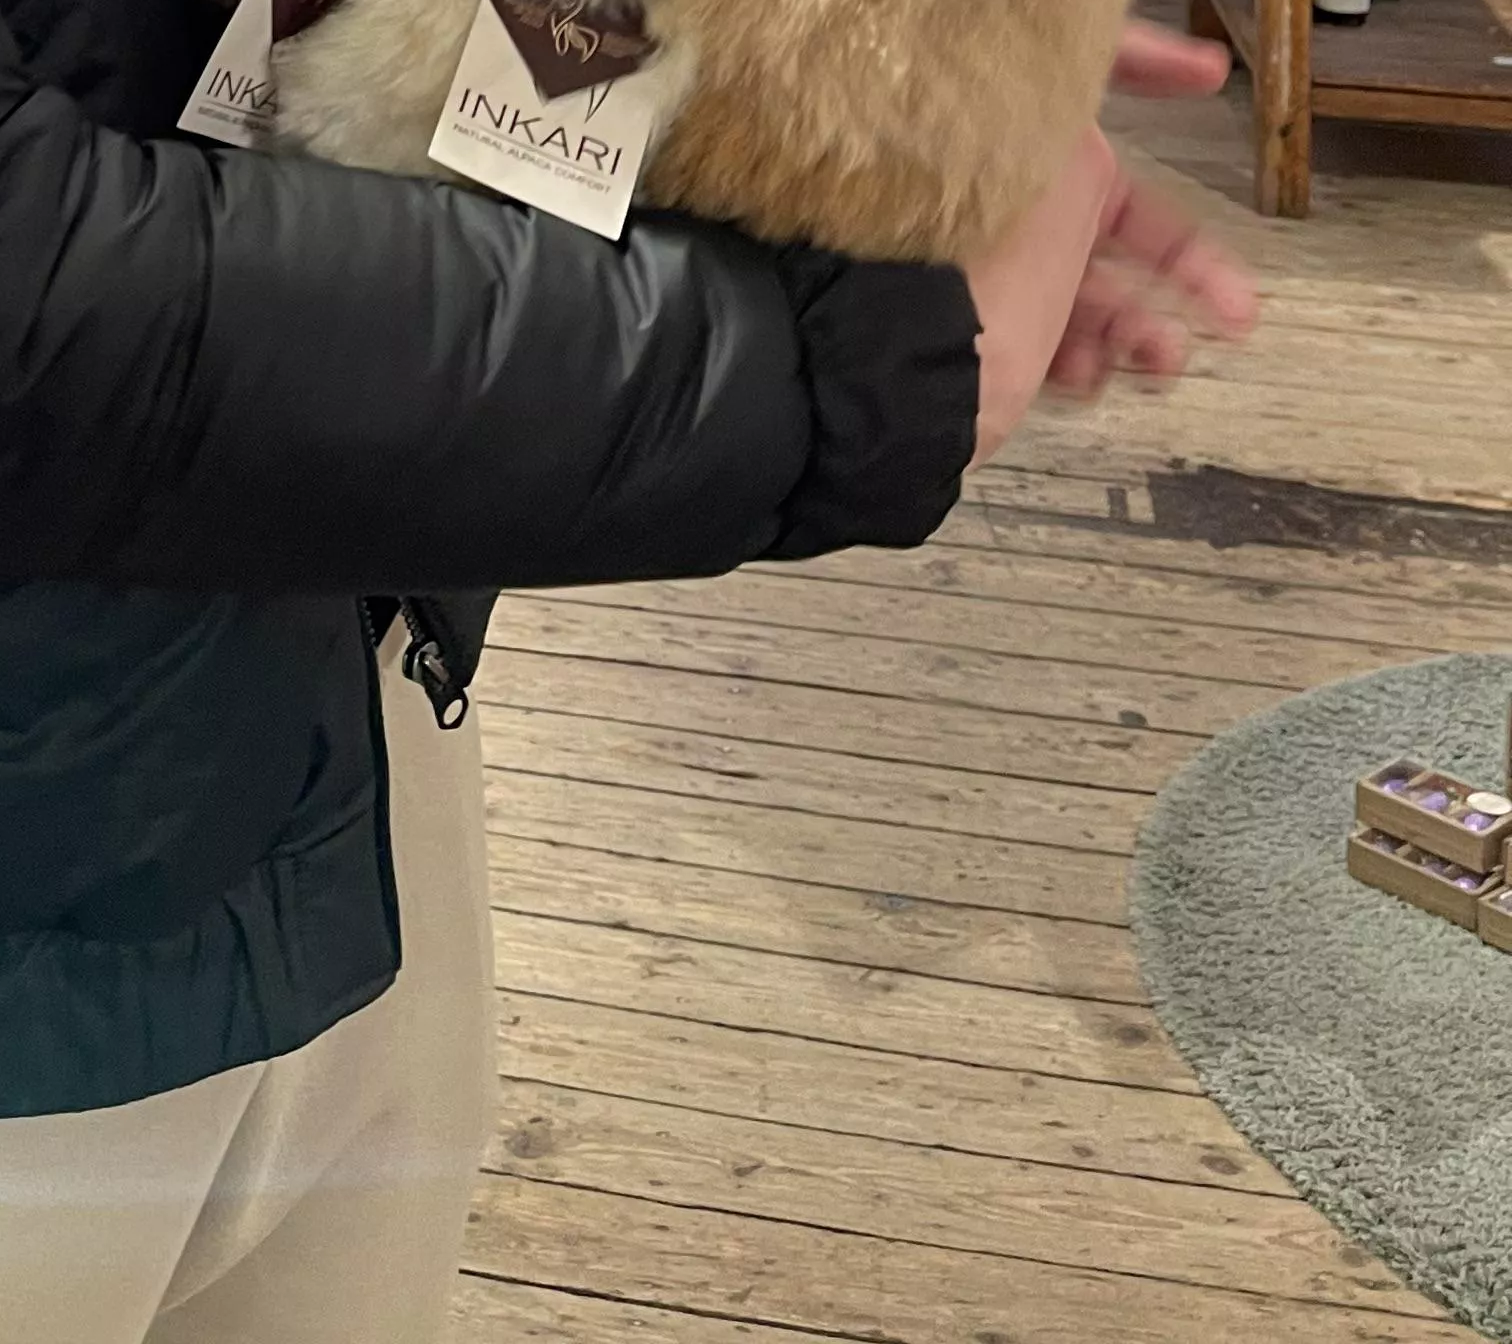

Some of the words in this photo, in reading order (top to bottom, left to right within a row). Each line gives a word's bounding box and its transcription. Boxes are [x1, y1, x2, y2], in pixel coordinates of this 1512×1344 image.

[453, 123, 504, 152] NATURAL
[554, 166, 612, 195] COMFORT
[458, 87, 623, 176] INKARI
